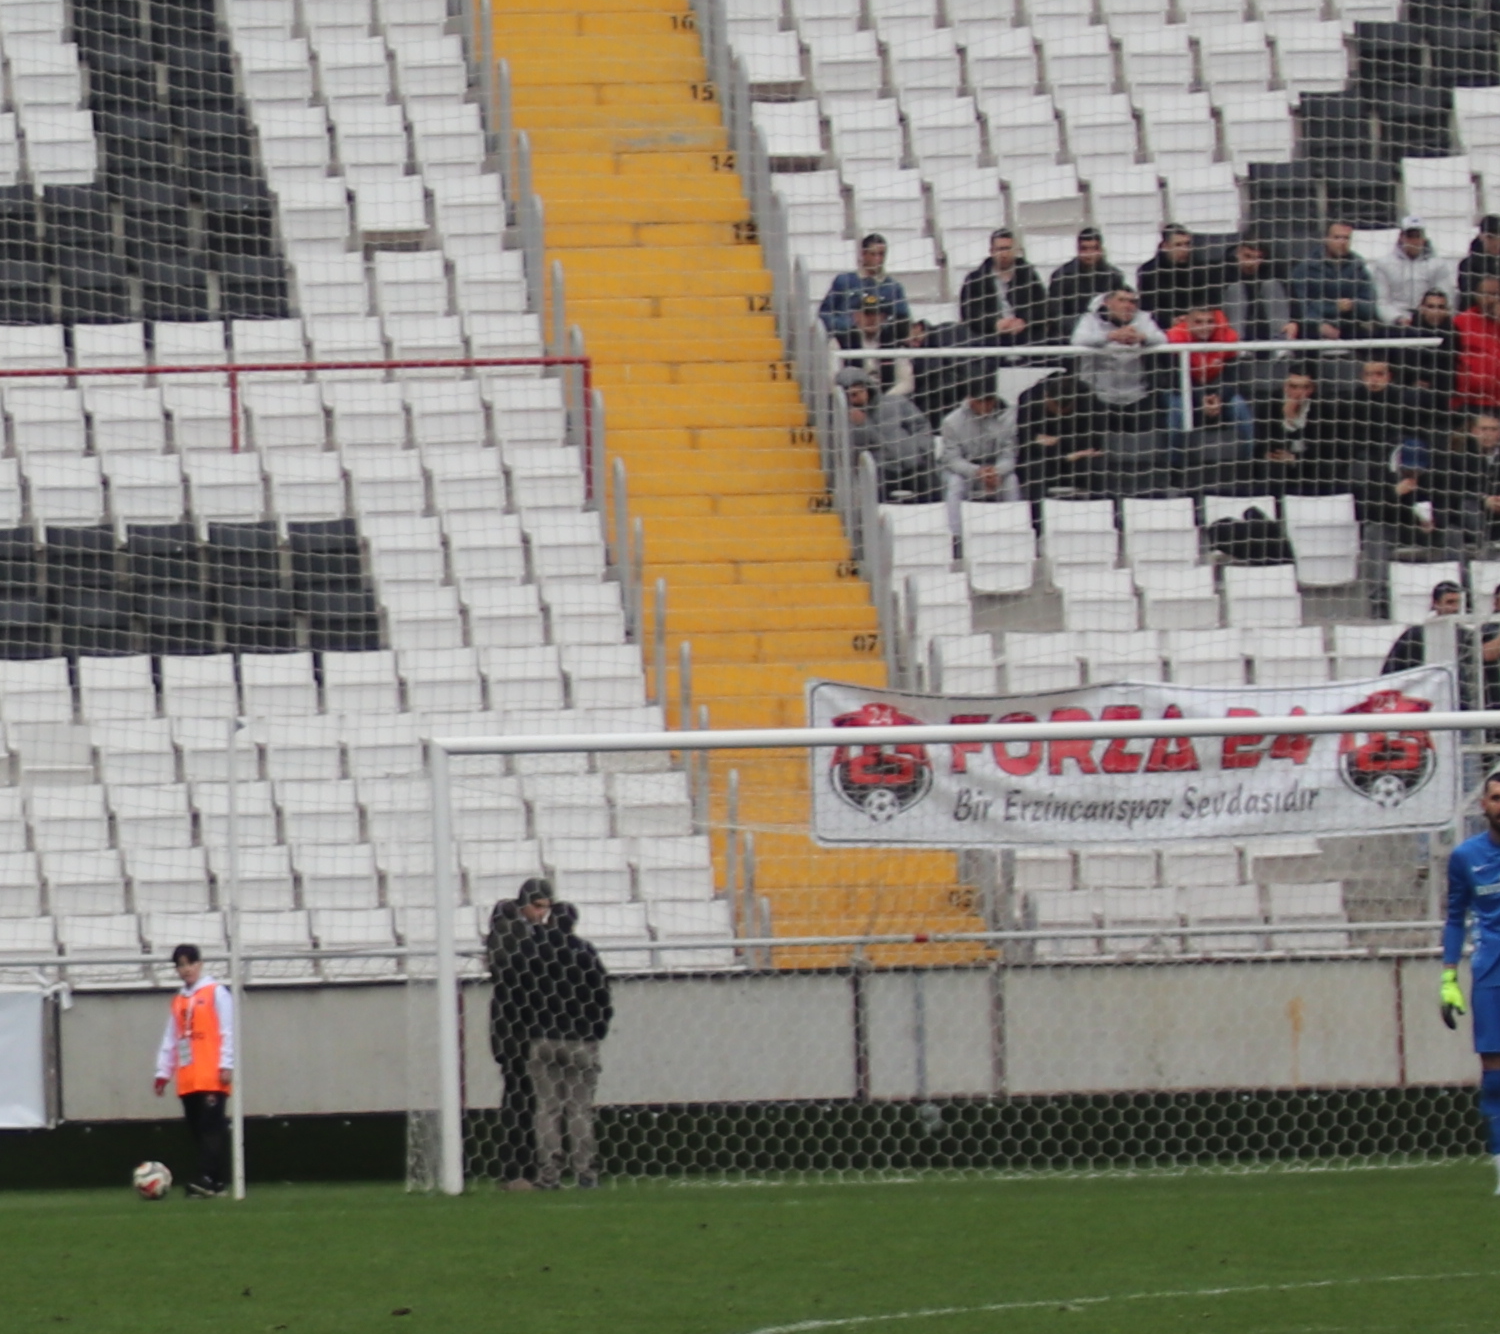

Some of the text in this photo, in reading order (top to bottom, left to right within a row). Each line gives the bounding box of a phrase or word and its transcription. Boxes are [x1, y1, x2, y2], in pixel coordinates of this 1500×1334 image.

[670, 15, 694, 31] 16
[690, 84, 714, 101] 15
[710, 154, 735, 171] 14
[747, 295, 772, 312] 12
[769, 363, 793, 380] 11
[852, 634, 879, 652] 07
[949, 703, 1201, 776] FORZA
[953, 787, 994, 822] Bir
[1003, 788, 1172, 829] Erzincanspor
